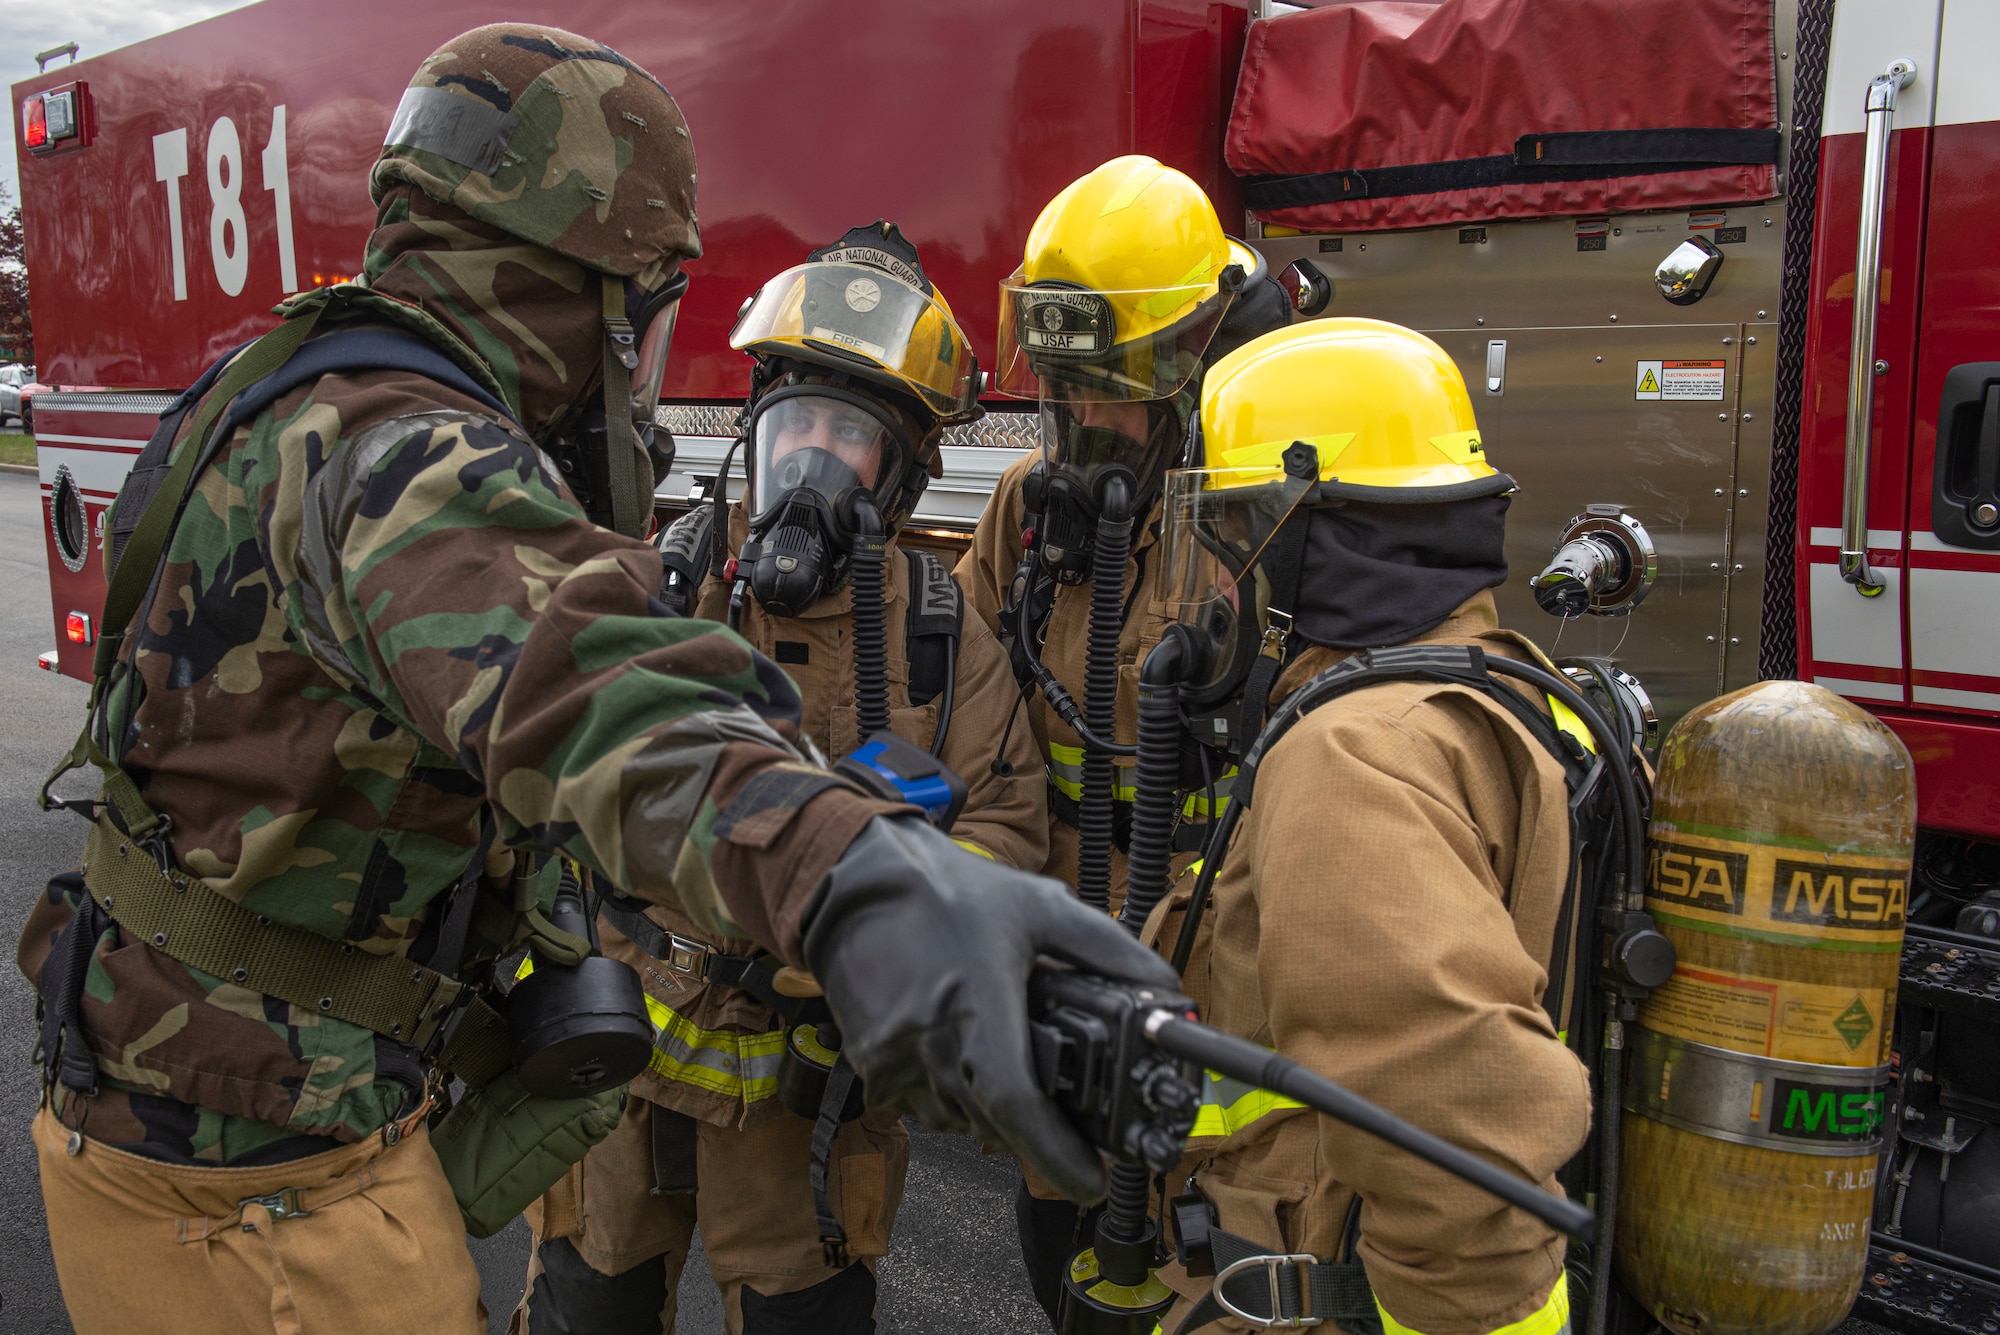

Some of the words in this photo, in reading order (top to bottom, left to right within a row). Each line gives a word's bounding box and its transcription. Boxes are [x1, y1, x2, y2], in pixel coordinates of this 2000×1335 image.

[152, 104, 298, 301] T81
[828, 252, 843, 263] AIR
[845, 249, 888, 267] NATIONAL
[1066, 293, 1097, 313] GUARD
[1040, 333, 1074, 348] USAF
[1784, 870, 1906, 922] MSA
[645, 966, 678, 991] RICOCHET
